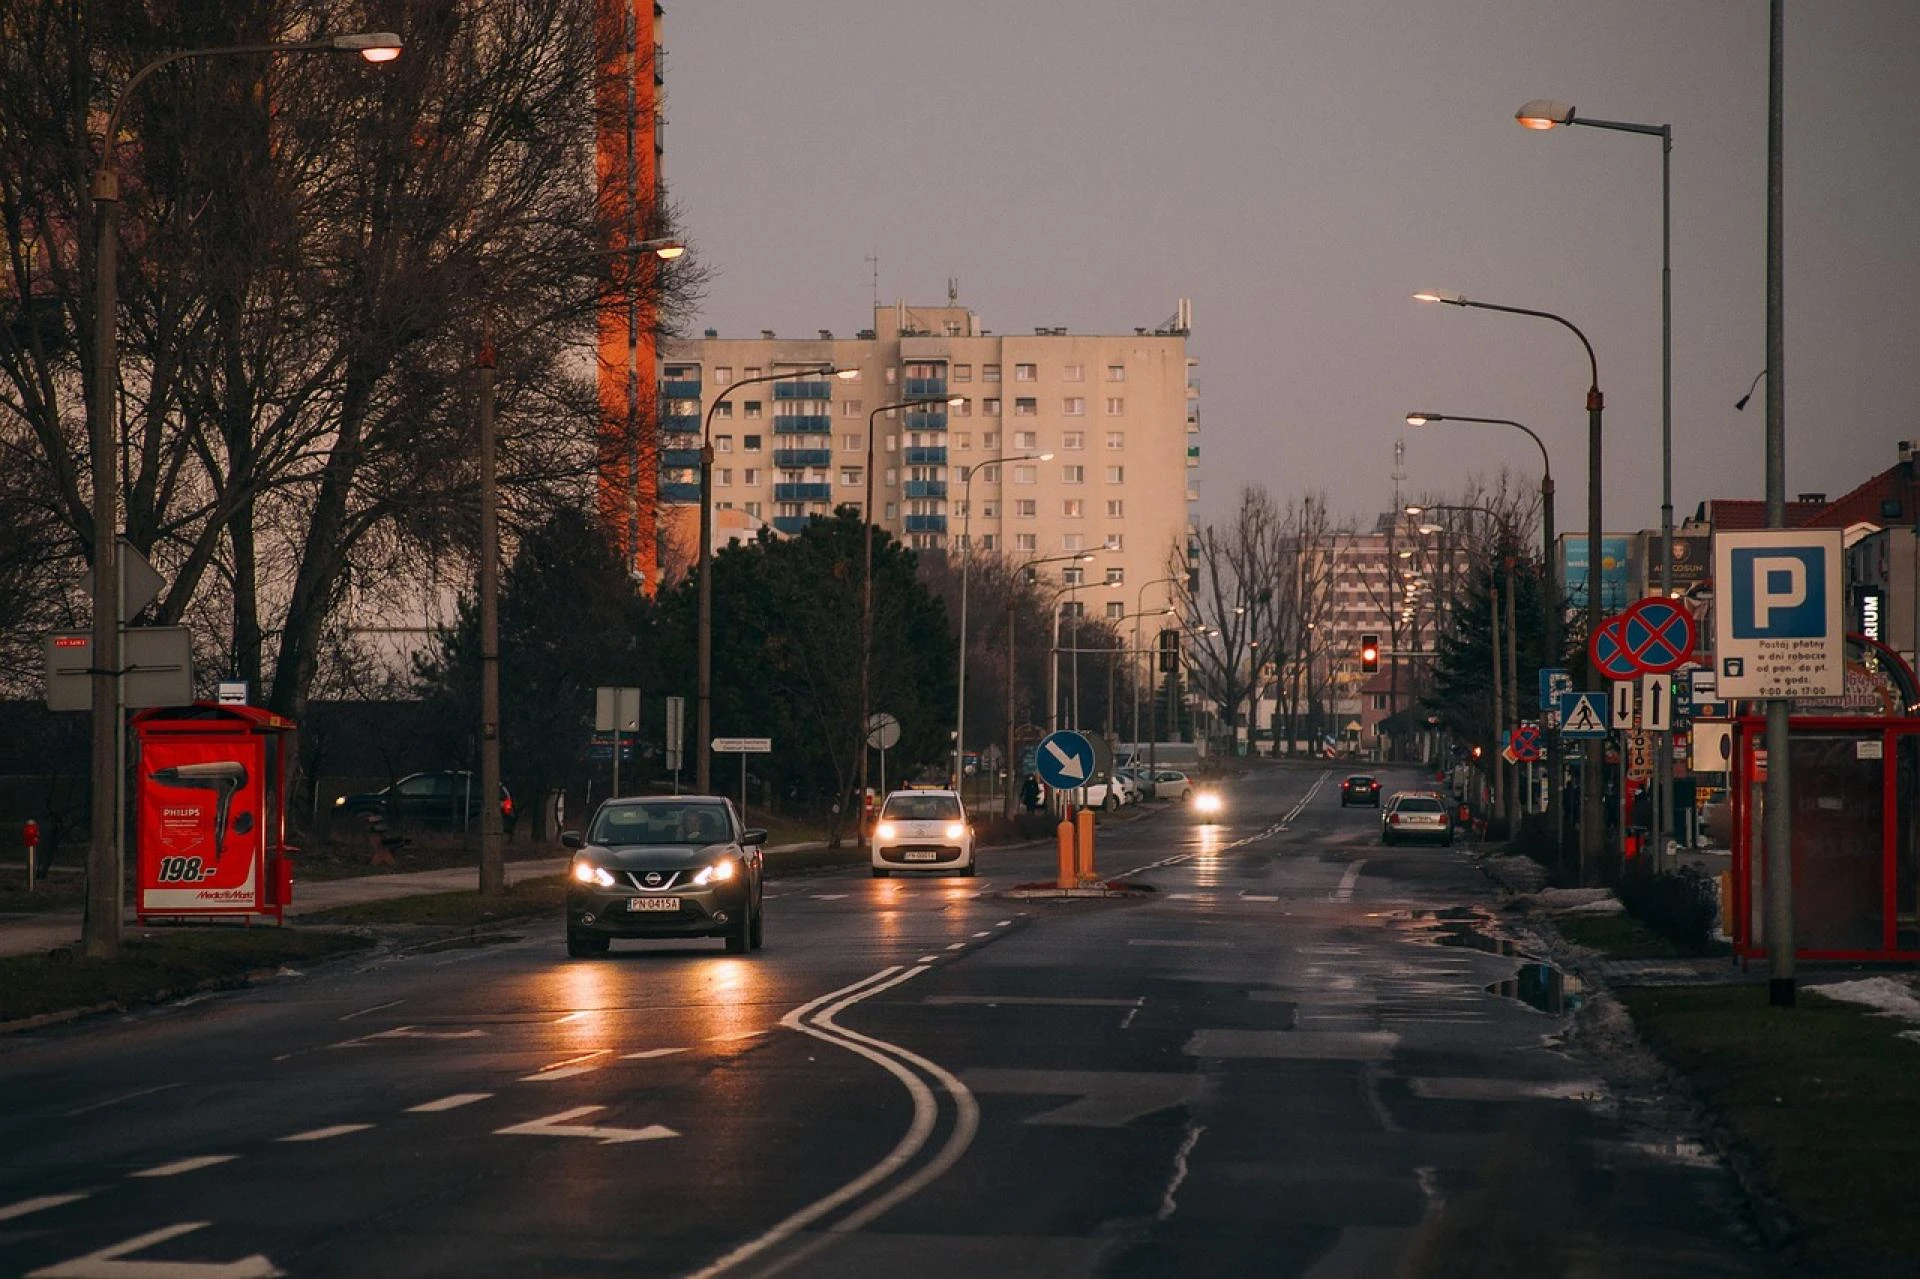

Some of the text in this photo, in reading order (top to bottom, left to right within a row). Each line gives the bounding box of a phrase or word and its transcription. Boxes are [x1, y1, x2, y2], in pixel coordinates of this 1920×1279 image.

[1753, 556, 1807, 629] P
[1769, 652, 1784, 660] dni
[1787, 652, 1827, 661] robocze
[1756, 663, 1769, 672] od
[1772, 665, 1794, 674] pon.
[1798, 664, 1811, 672] do
[1785, 687, 1798, 695] do
[1801, 686, 1826, 695] 17:00
[163, 808, 201, 817] PHILIPS
[158, 855, 218, 882] 198.-
[632, 898, 678, 909] PN 0415A
